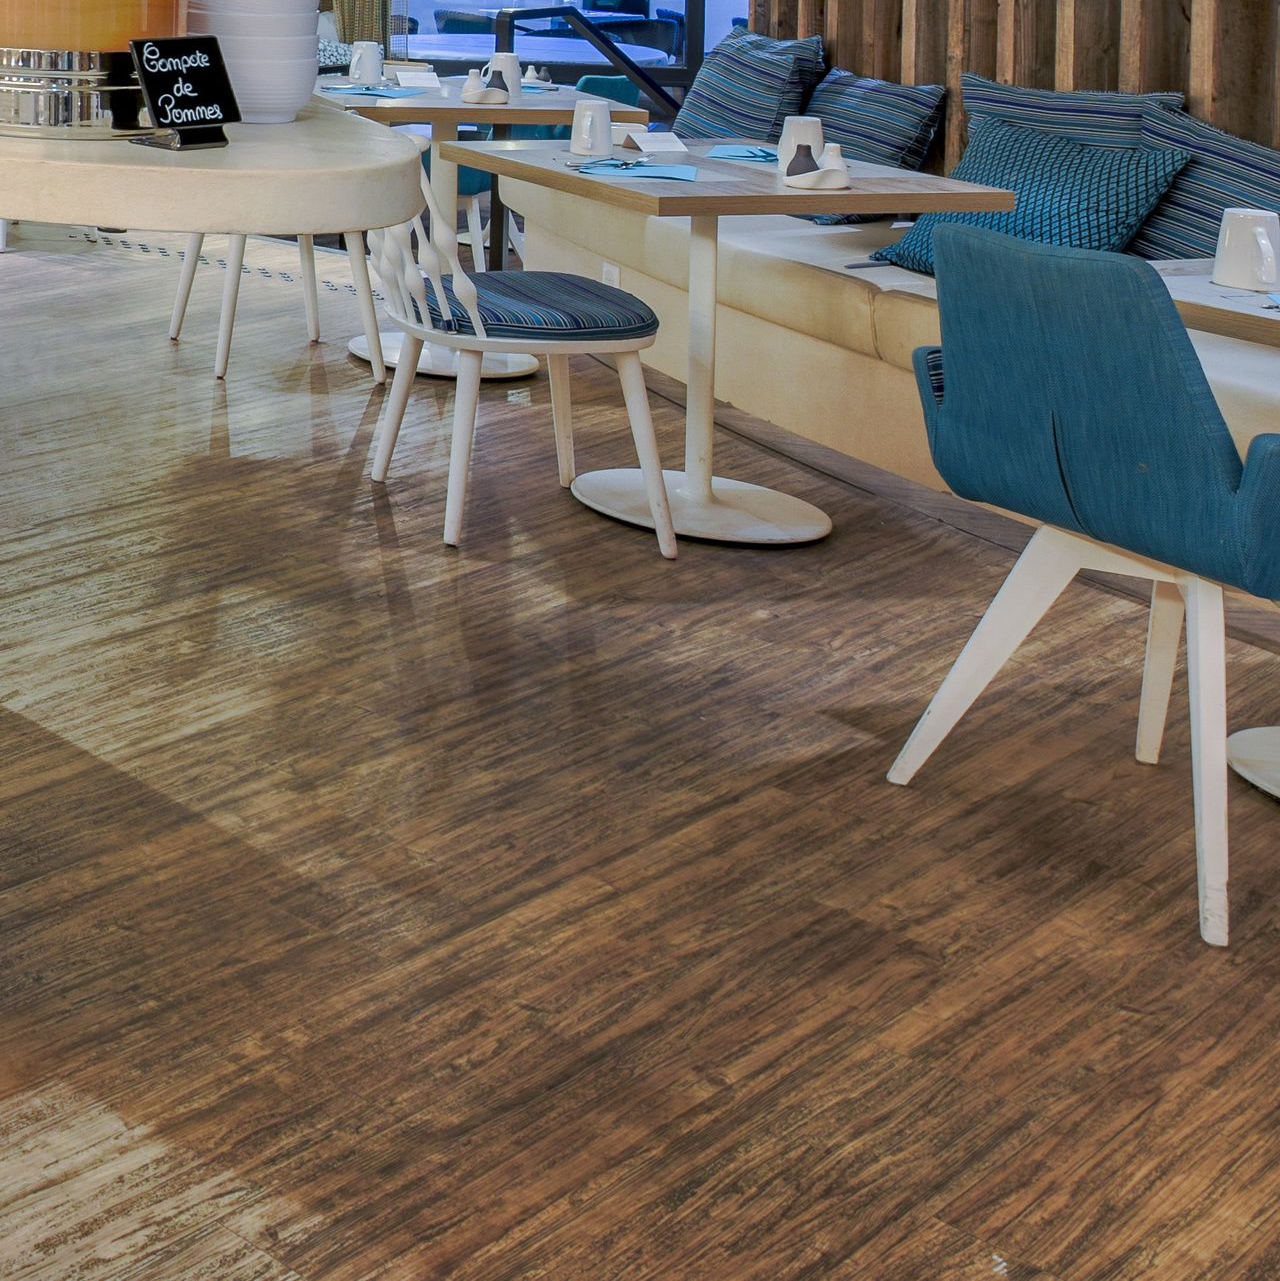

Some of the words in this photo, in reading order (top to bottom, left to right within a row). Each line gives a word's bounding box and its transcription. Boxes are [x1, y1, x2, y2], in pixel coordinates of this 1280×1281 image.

[143, 42, 210, 74] Compote
[173, 77, 199, 97] de
[158, 94, 223, 123] Pommes
